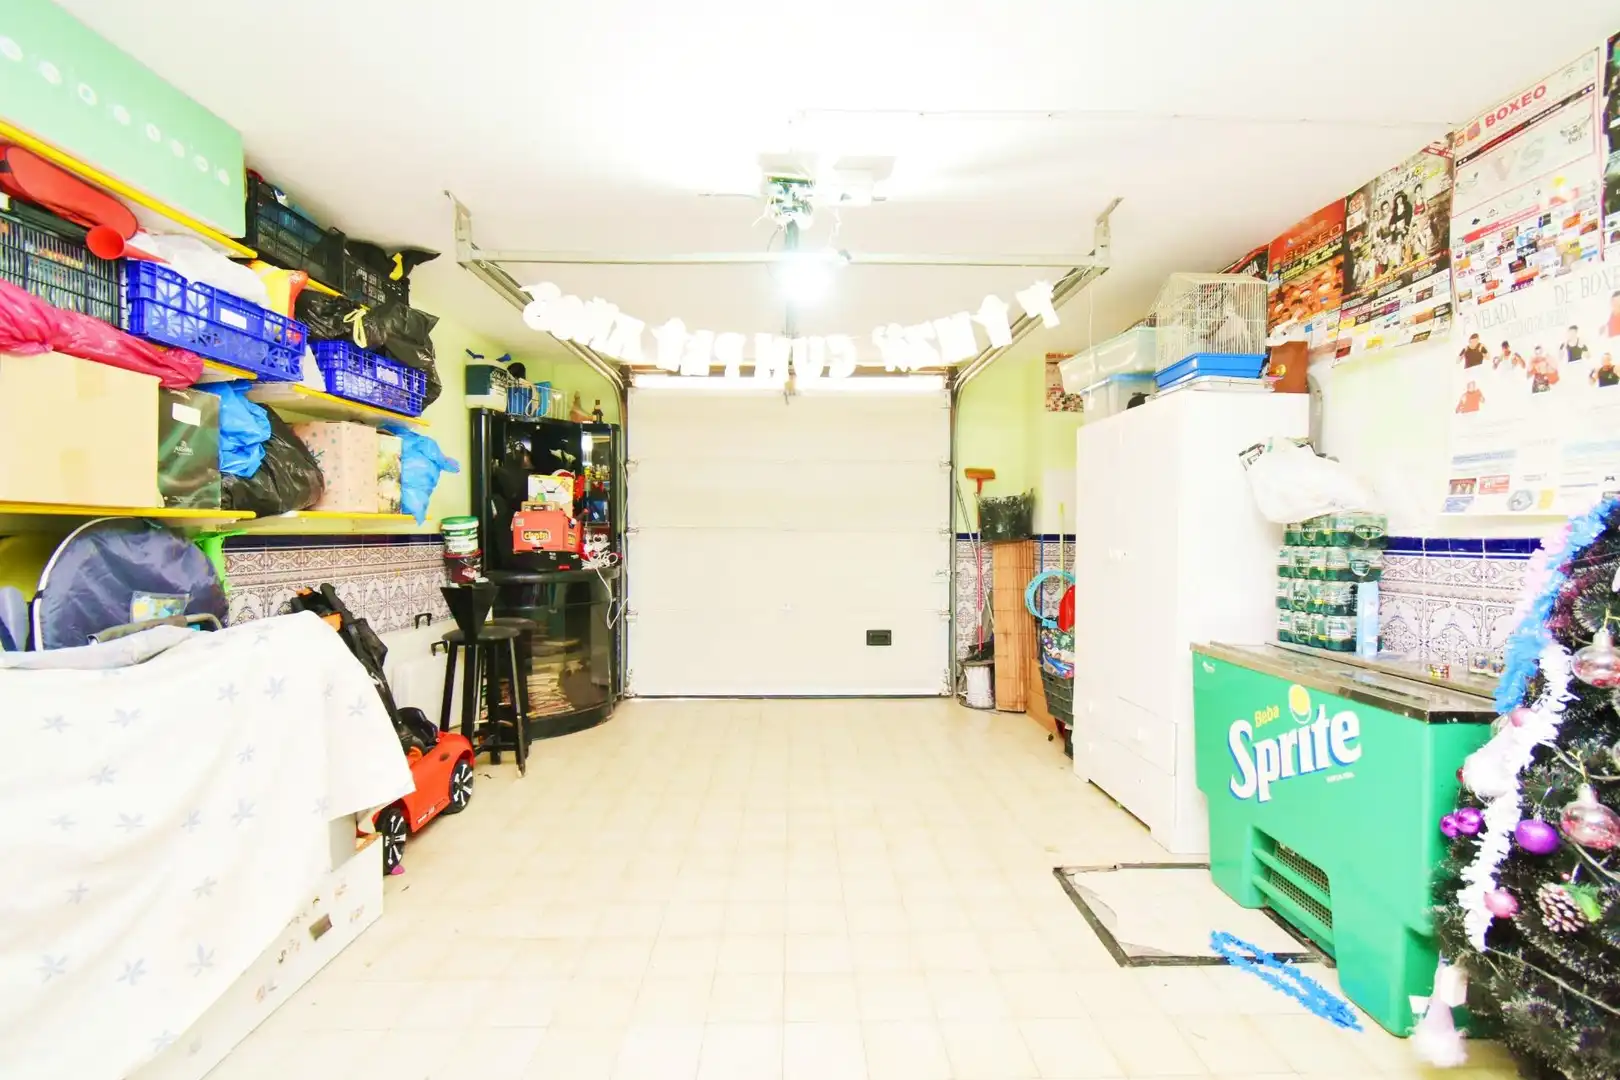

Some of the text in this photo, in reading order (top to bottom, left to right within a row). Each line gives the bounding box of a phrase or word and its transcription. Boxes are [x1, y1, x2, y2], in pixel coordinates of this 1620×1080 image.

[1485, 84, 1546, 128] BOXEO
[1283, 223, 1342, 263] BOXEO
[1473, 299, 1518, 331] VELADA
[1553, 280, 1574, 306] DE
[1254, 705, 1280, 728] Beba
[1228, 704, 1363, 803] Sprite
